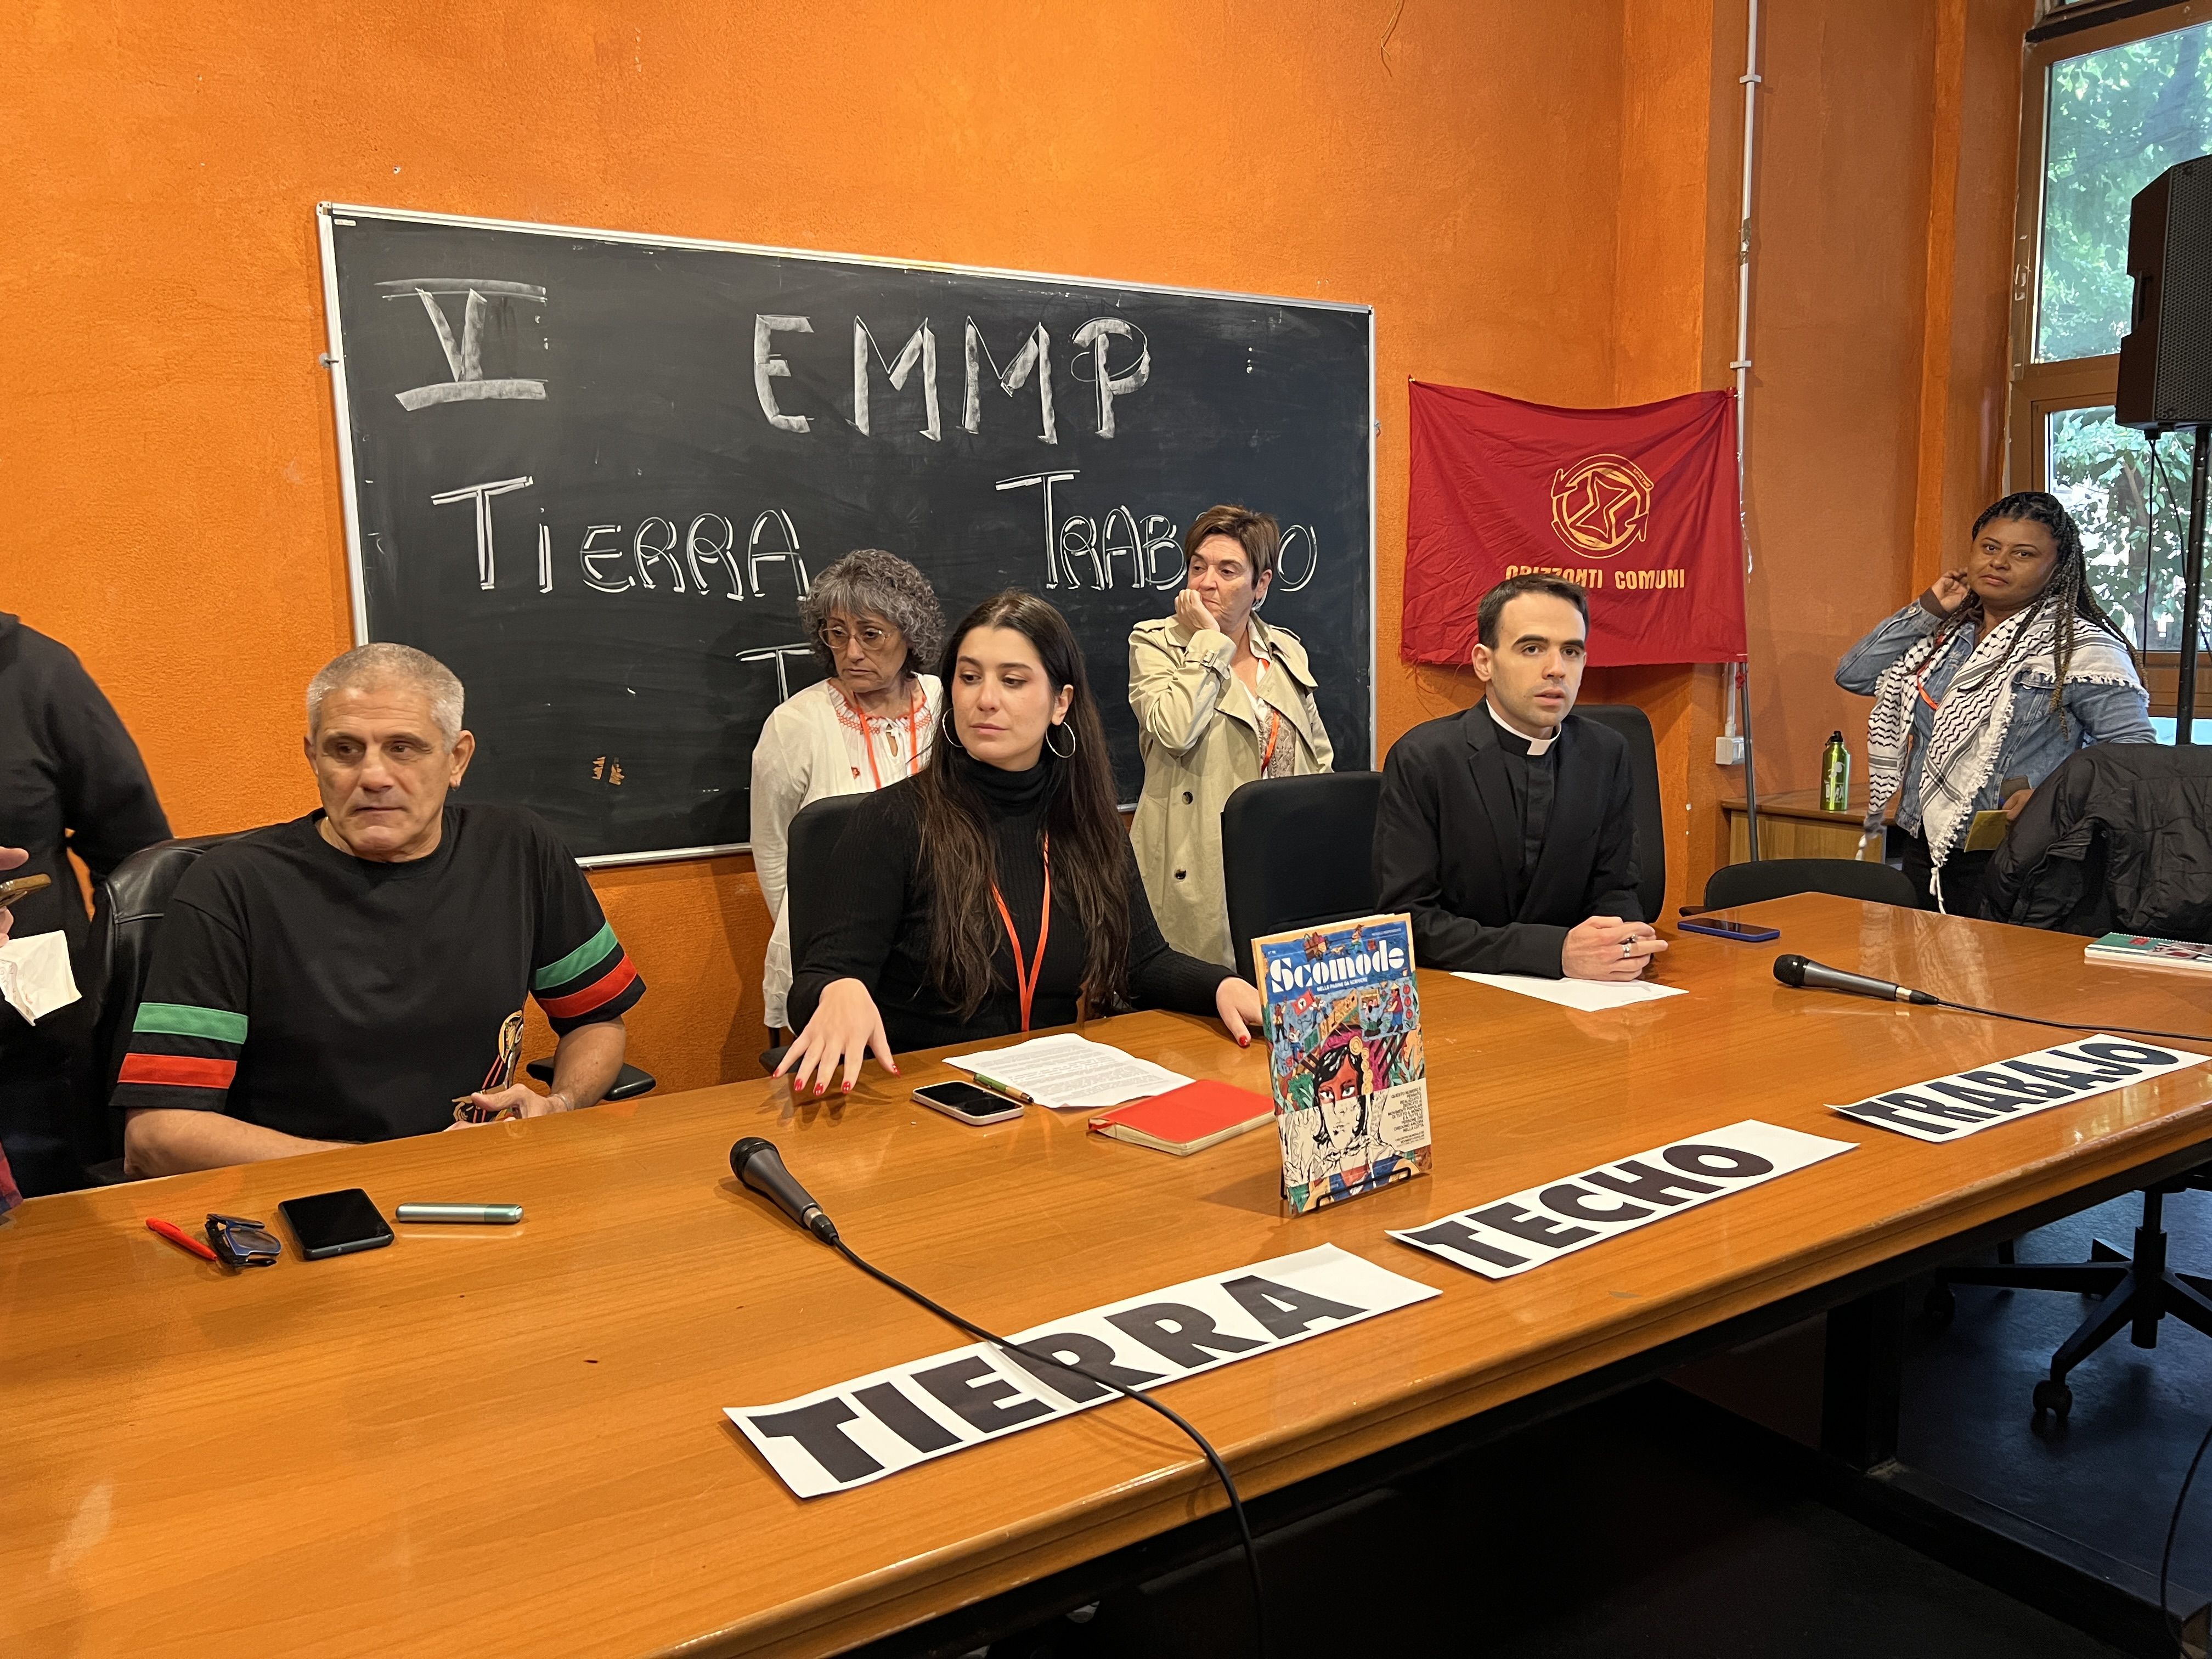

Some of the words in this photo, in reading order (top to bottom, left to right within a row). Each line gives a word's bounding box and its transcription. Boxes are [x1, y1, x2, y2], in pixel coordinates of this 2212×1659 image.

[754, 314, 1151, 444] EMMP
[996, 470, 1317, 610] TRABO
[1615, 569, 1685, 589] COMUNI
[1846, 1043, 2179, 1135] TRABAJO
[1401, 1144, 1773, 1268] TECHO
[747, 1275, 1370, 1483] TIERRA
